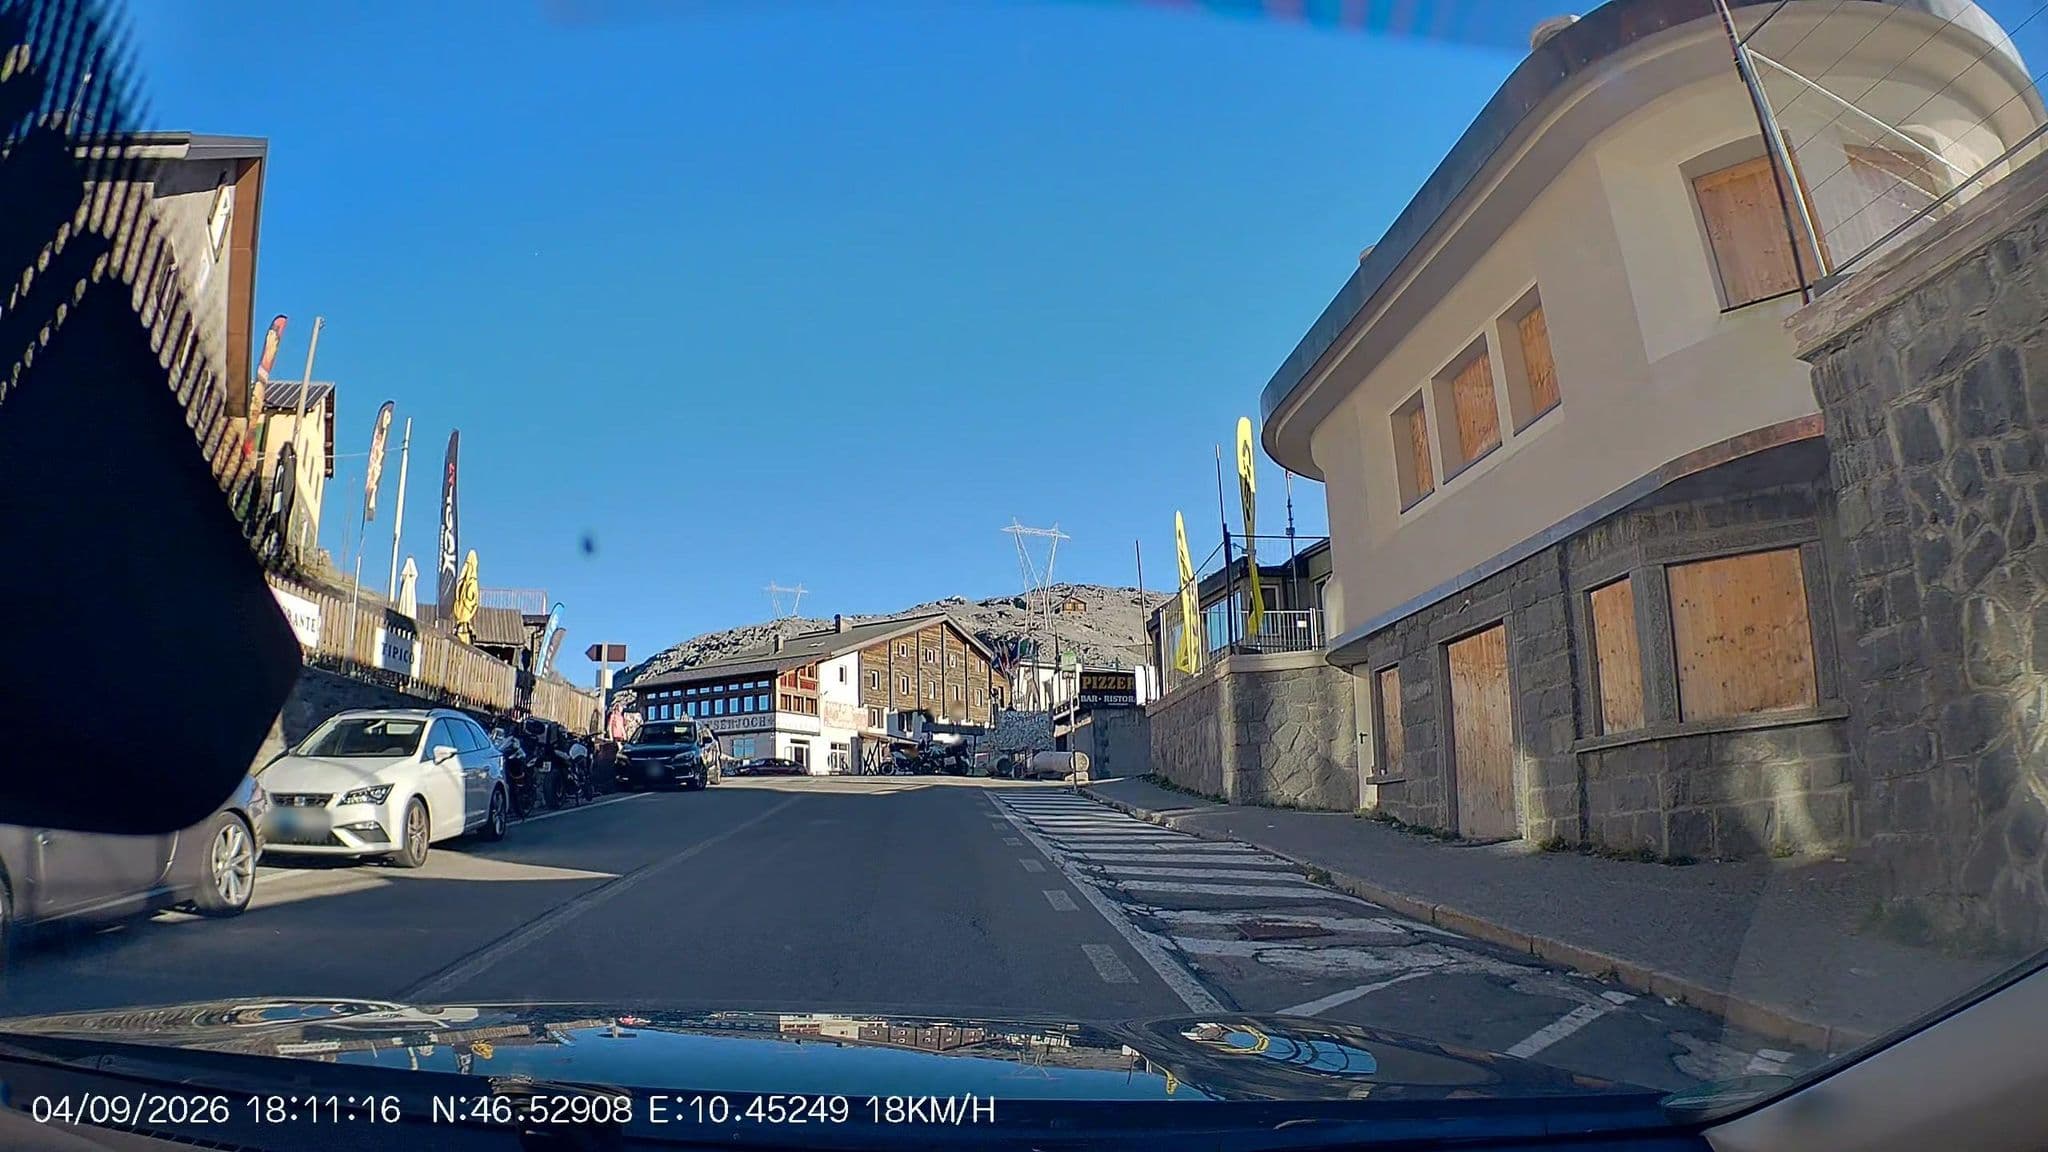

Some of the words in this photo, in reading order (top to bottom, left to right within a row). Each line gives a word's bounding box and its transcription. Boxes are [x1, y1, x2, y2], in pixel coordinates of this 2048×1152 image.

[282, 605, 316, 633] RANTE
[381, 642, 415, 665] TIPICO
[1080, 694, 1098, 703] BAR
[1103, 695, 1136, 703] RISTOR
